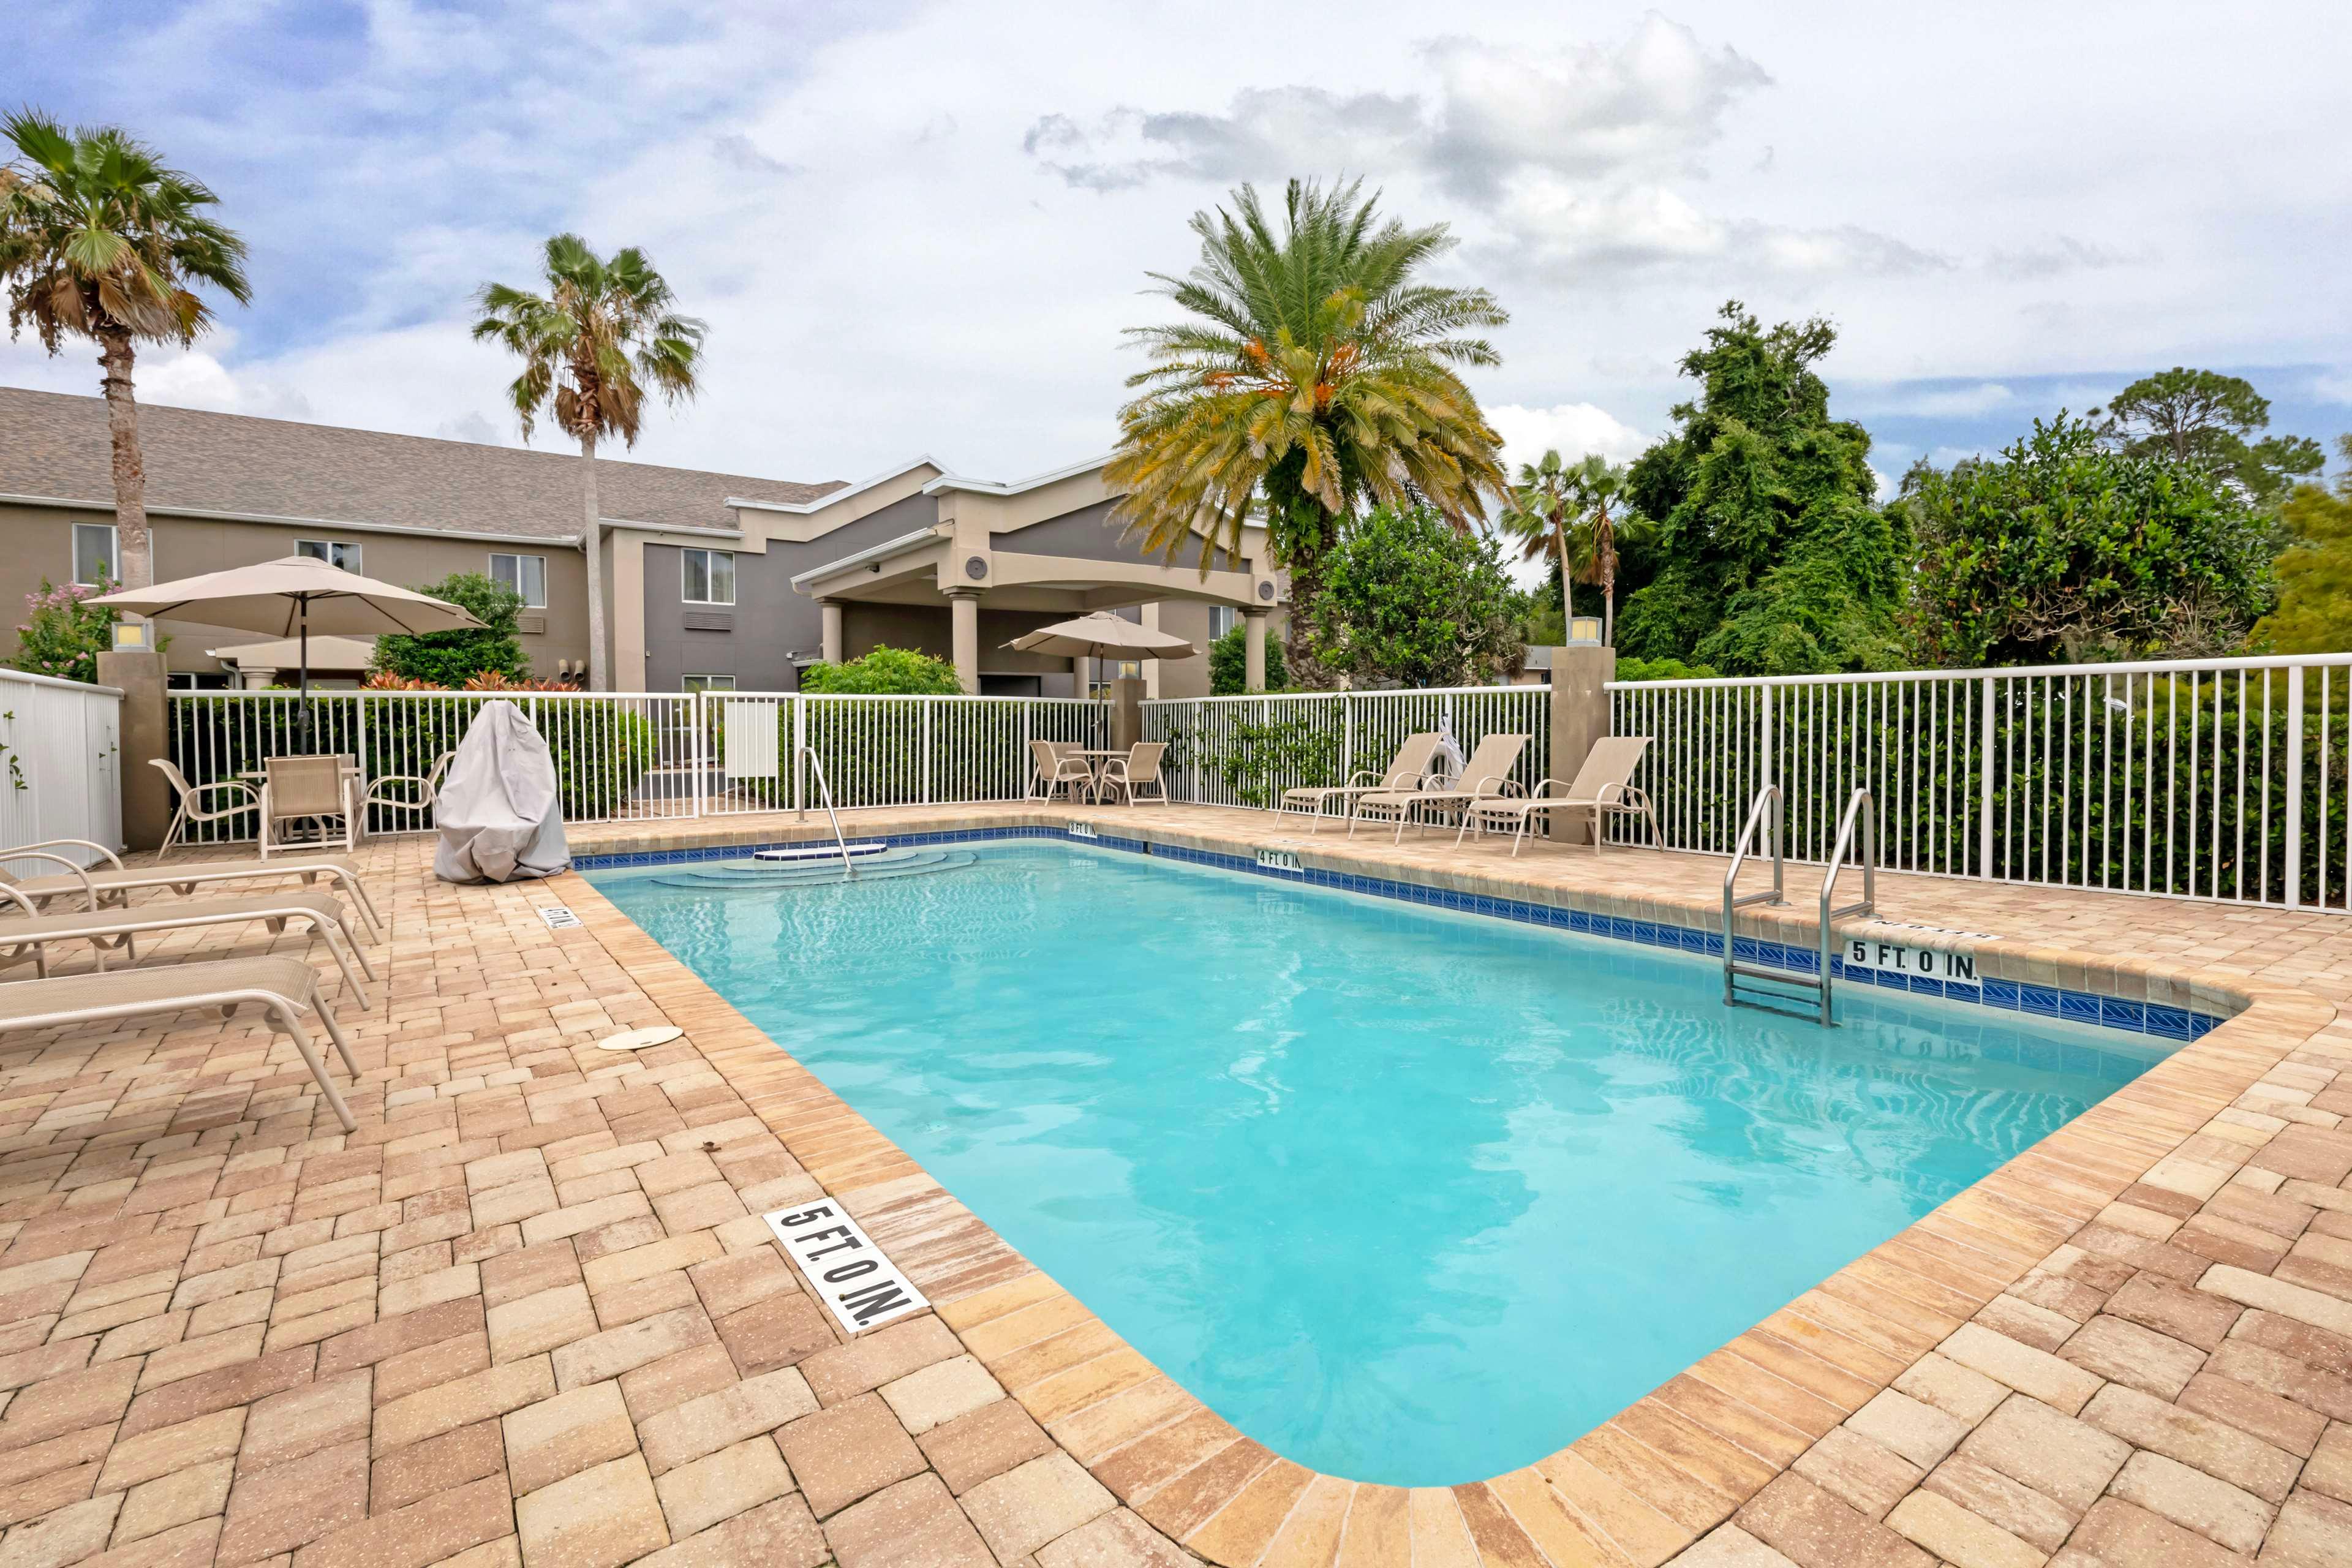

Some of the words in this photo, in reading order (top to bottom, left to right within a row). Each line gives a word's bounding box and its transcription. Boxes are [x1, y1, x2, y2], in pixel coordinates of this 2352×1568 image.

[1071, 823, 1074, 832] 3
[1260, 851, 1265, 863] 4
[1283, 854, 1288, 866] 0
[1853, 941, 1866, 962] 5
[1879, 944, 1905, 969] FT.
[1919, 951, 1932, 972] 0
[1947, 954, 1978, 981] IN.
[781, 1206, 834, 1227] 5
[794, 1224, 863, 1262] FT.
[823, 1259, 878, 1283] 0
[840, 1280, 912, 1326] IN.
